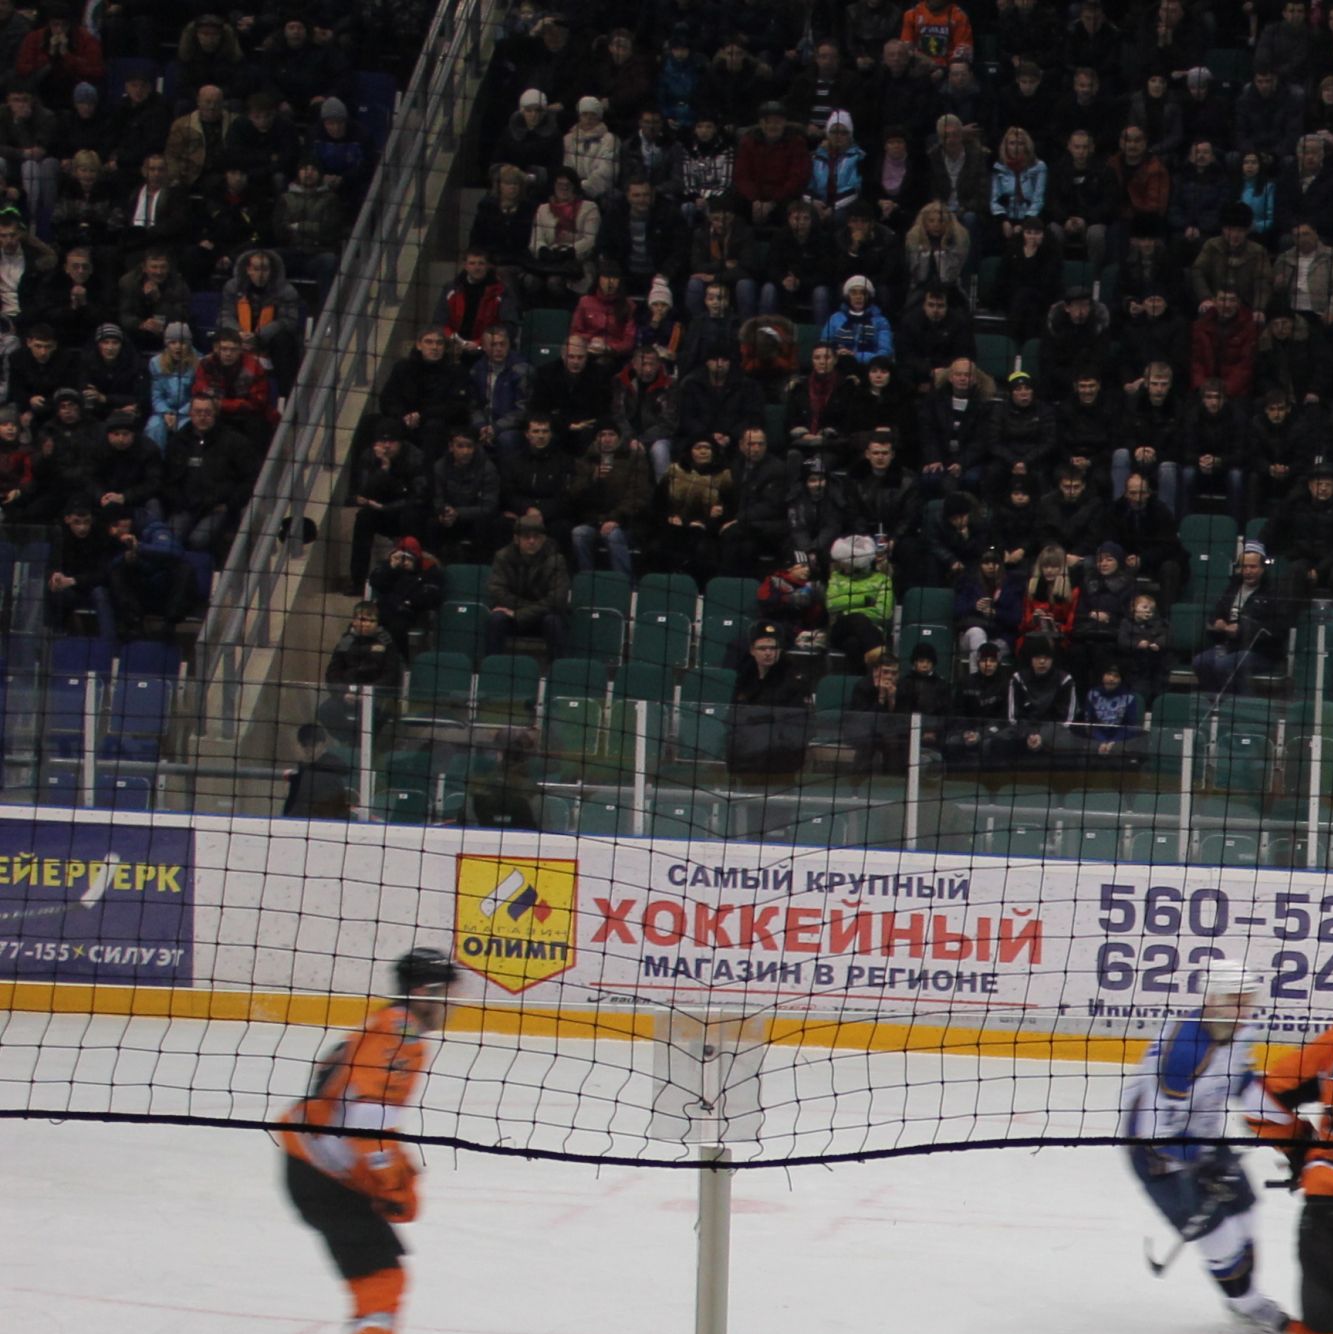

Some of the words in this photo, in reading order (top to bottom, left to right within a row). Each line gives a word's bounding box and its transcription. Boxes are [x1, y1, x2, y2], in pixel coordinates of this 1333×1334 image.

[667, 863, 794, 892] САМЫЙ
[806, 869, 970, 901] КРУПНЫЙ
[463, 936, 568, 960] ОЛИМП
[591, 897, 1042, 966] ХОККЕЙНЫЙ
[88, 945, 184, 967] СИЛУЭТ
[643, 955, 801, 985] МАГАЗИН
[814, 962, 835, 986] В
[847, 965, 999, 993] РЕГИОНЕ
